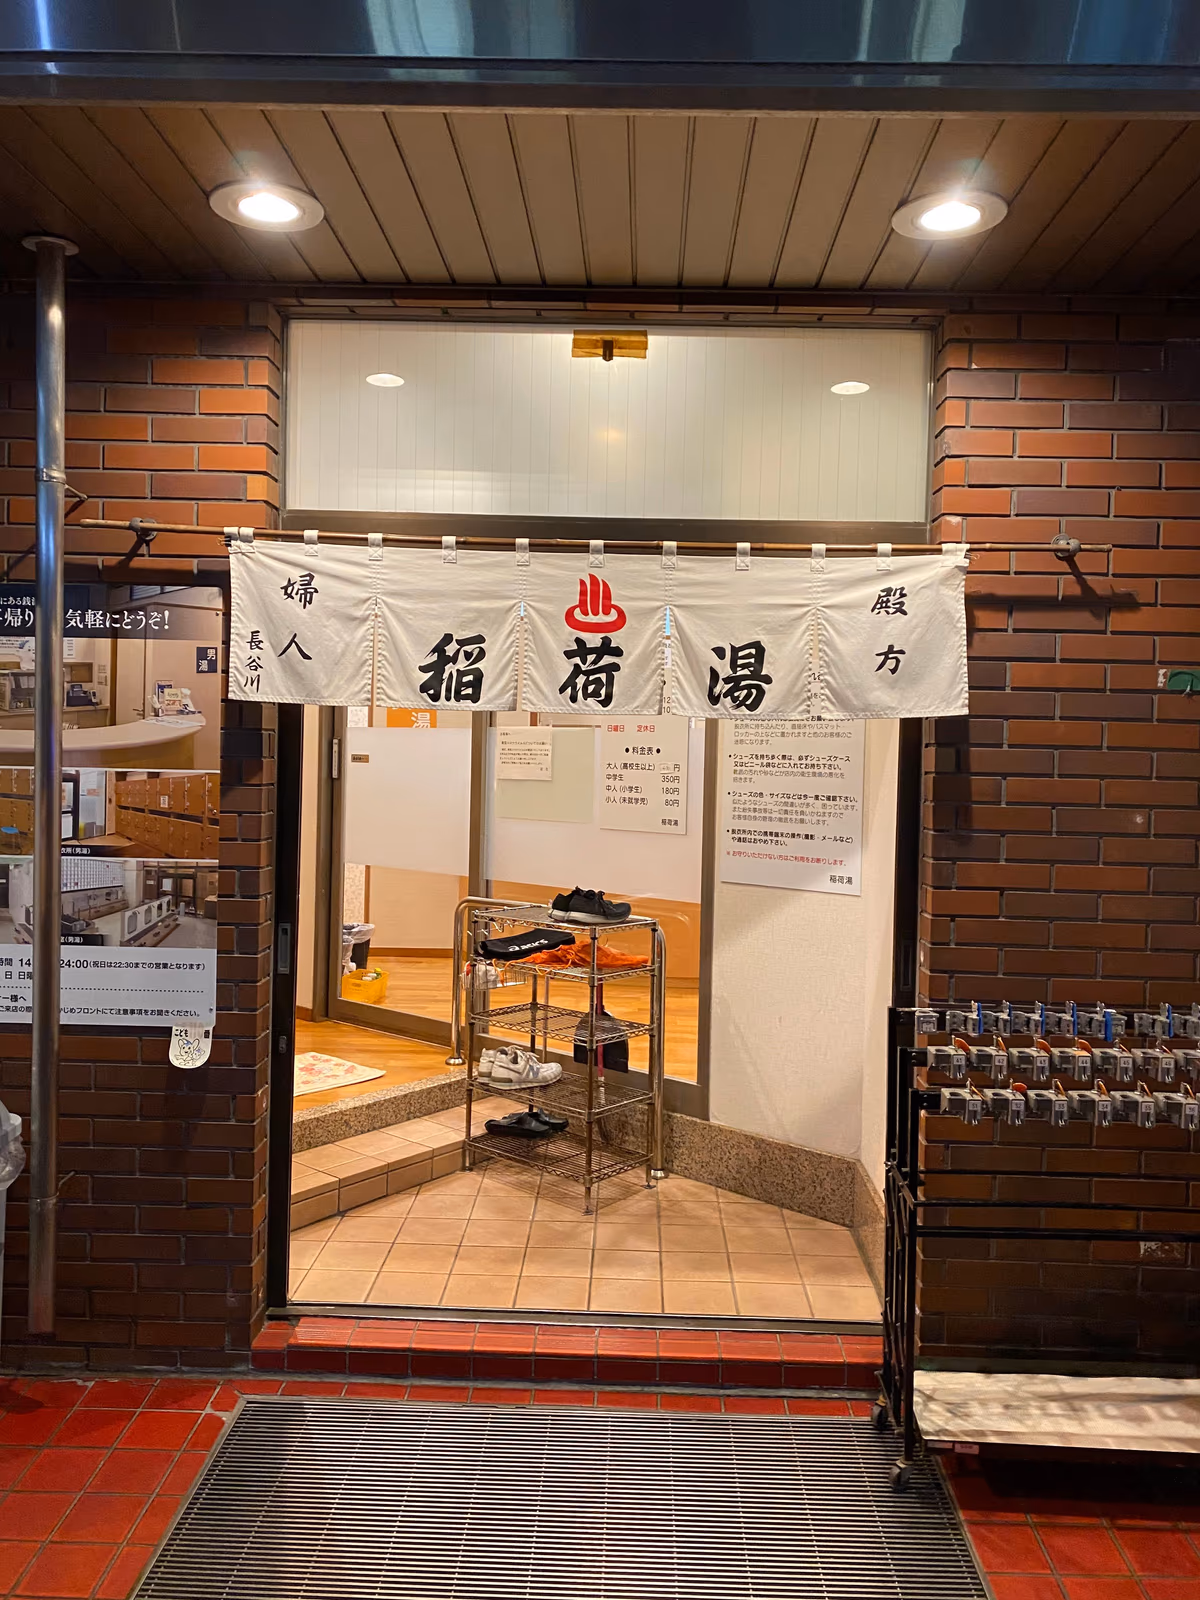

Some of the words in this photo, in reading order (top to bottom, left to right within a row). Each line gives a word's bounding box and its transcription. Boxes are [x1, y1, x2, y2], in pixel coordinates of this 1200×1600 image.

[0, 607, 35, 628] 帰り
[278, 572, 319, 661] 婦人
[870, 586, 908, 675] 殿方
[243, 630, 264, 693] 長谷川
[418, 633, 773, 712] 稲荷湯
[632, 747, 654, 755] 料金表
[661, 776, 680, 784] 350円
[661, 787, 680, 795] 180円
[664, 799, 680, 808] 80円
